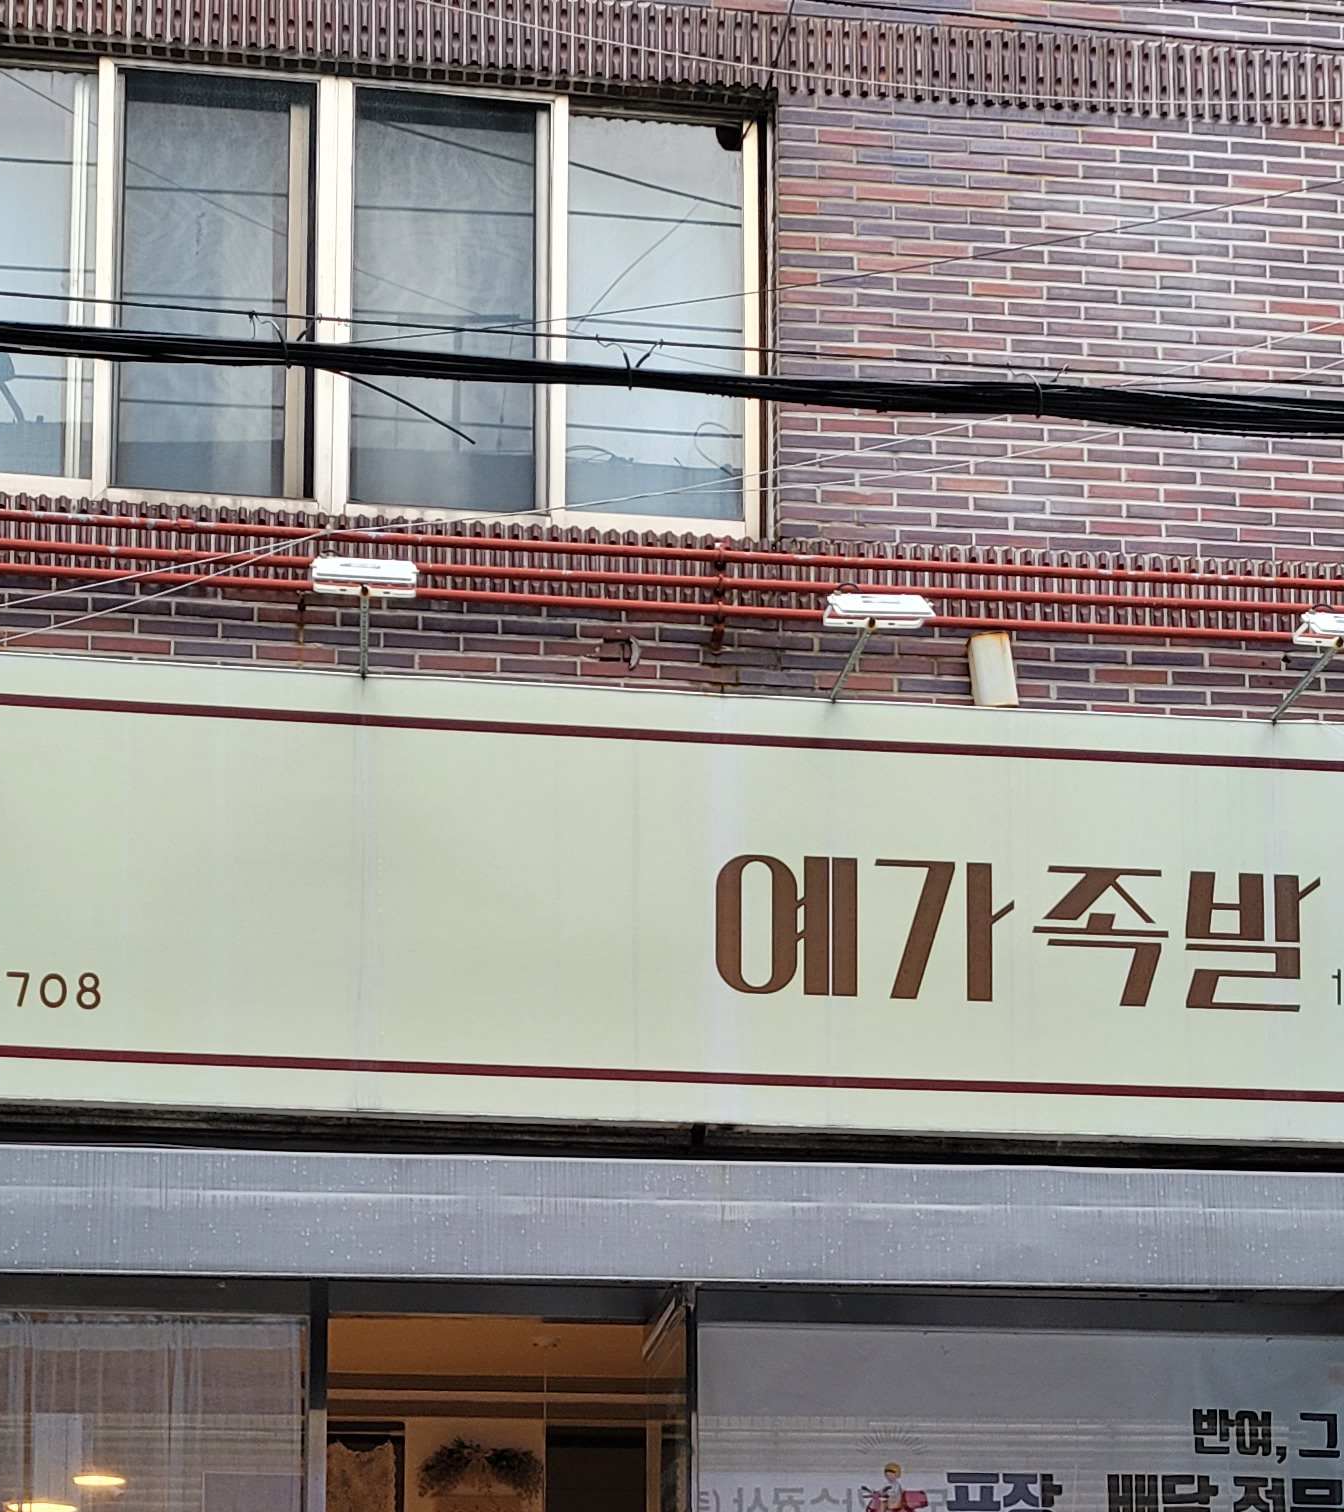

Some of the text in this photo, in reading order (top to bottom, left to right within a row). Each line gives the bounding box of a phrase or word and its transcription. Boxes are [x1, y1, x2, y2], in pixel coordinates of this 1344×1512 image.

[715, 854, 1321, 1013] 예가족발
[1192, 1408, 1289, 1463] 반여,
[1299, 1412, 1341, 1459] 그
